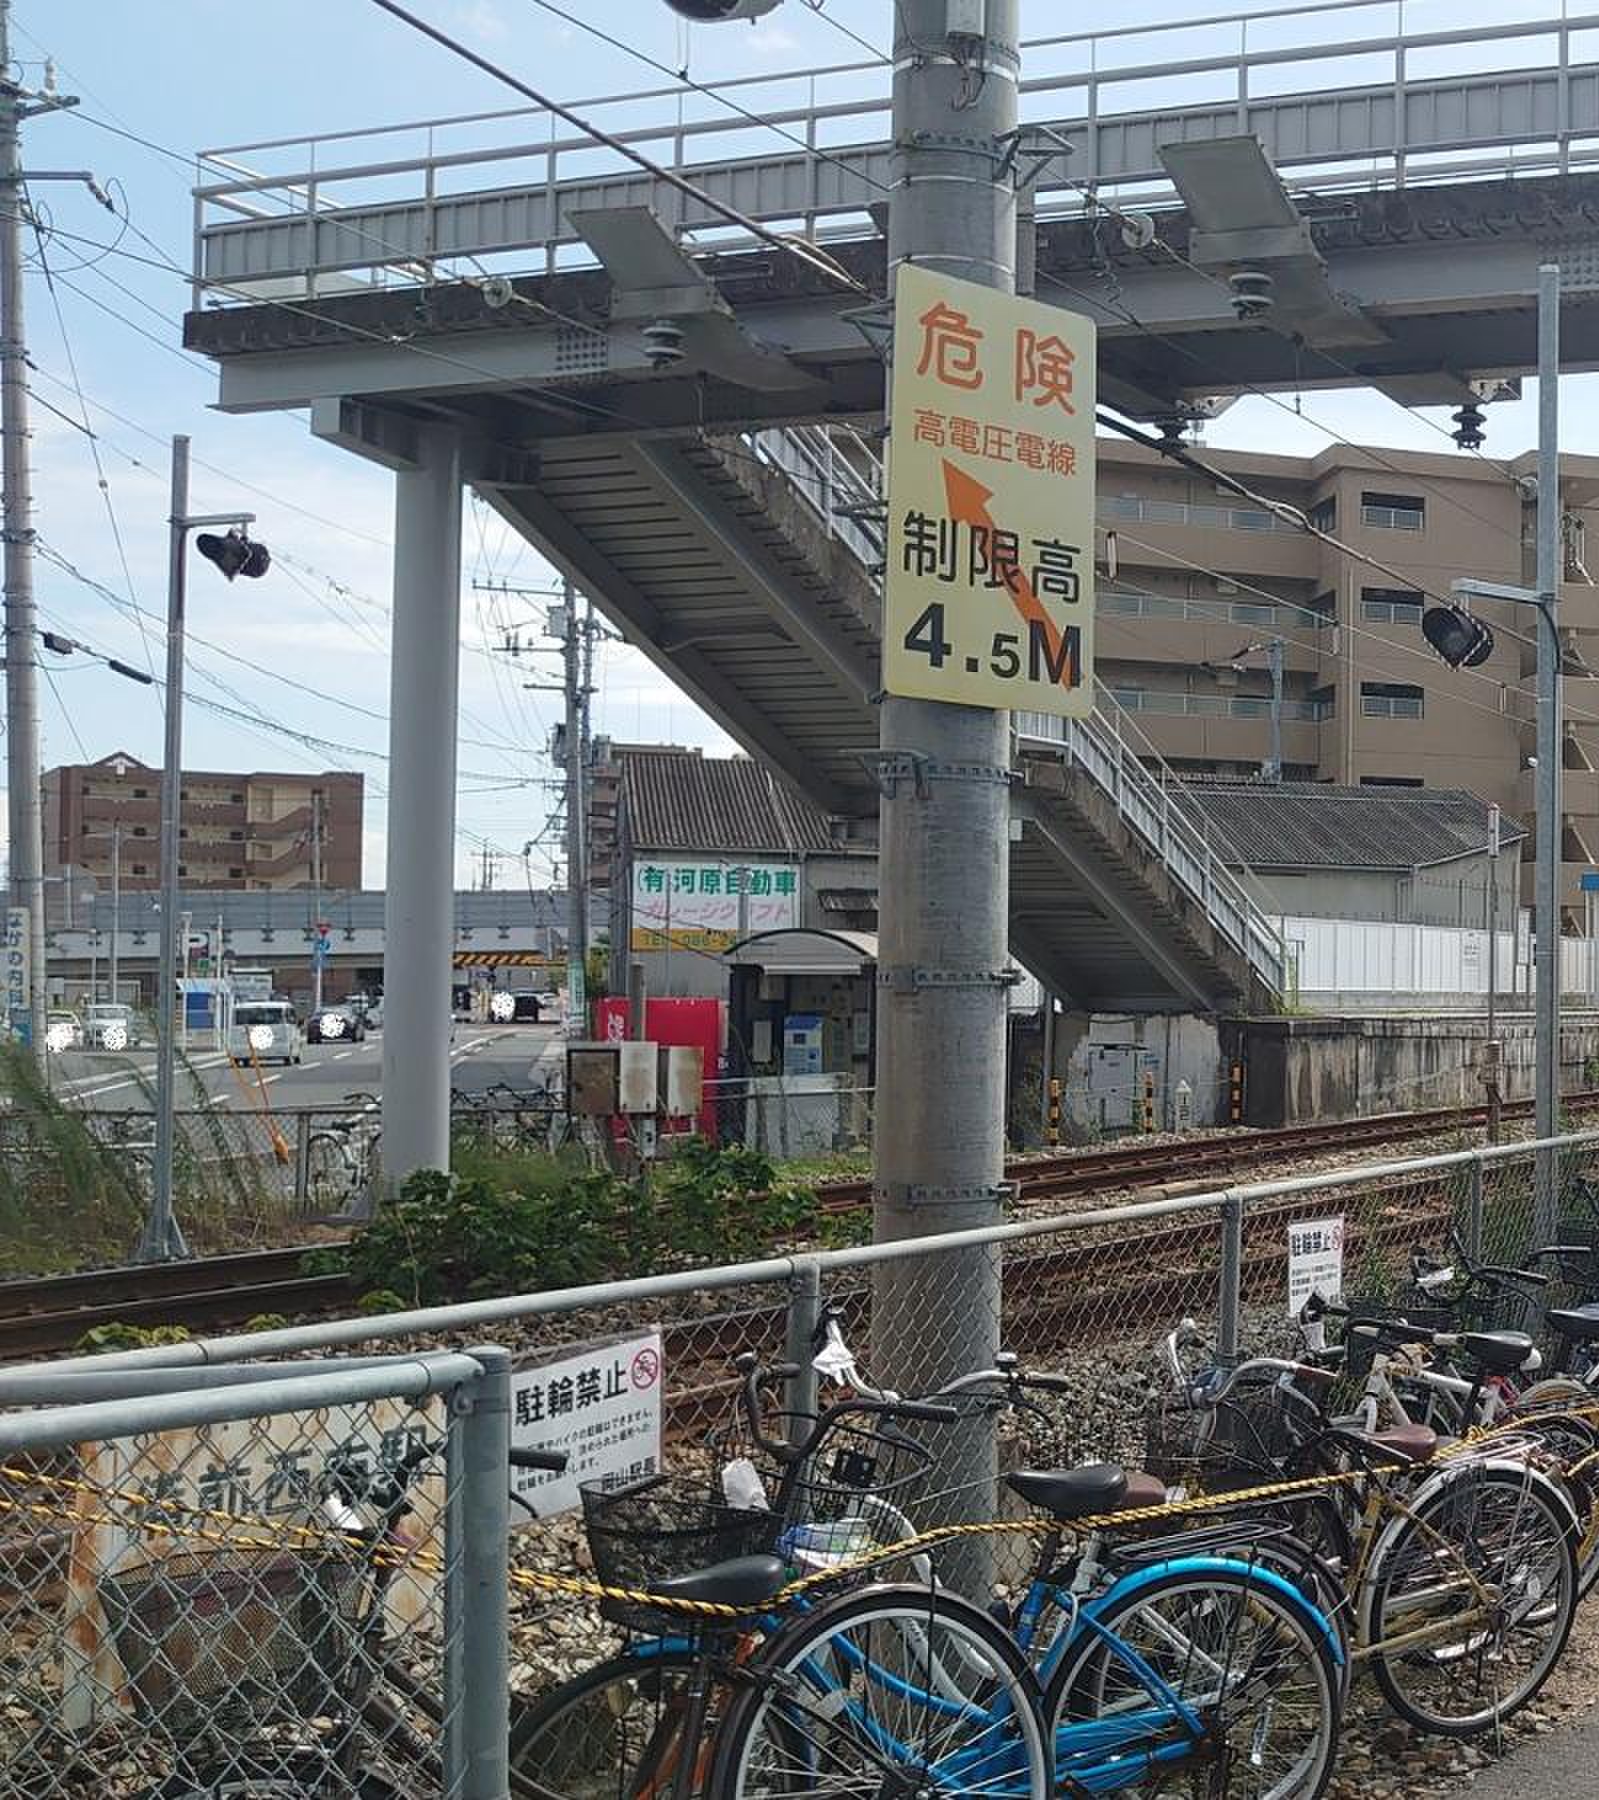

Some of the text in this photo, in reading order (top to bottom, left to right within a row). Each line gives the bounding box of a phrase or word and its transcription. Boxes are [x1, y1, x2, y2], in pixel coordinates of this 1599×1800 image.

[916, 301, 1076, 415] 危険
[913, 408, 1077, 477] 高電圧電線
[903, 510, 1081, 604] 制限高
[903, 601, 1082, 689] 4.5M
[639, 866, 796, 897] (有河原自動車
[515, 1359, 629, 1427] 駐輪禁止
